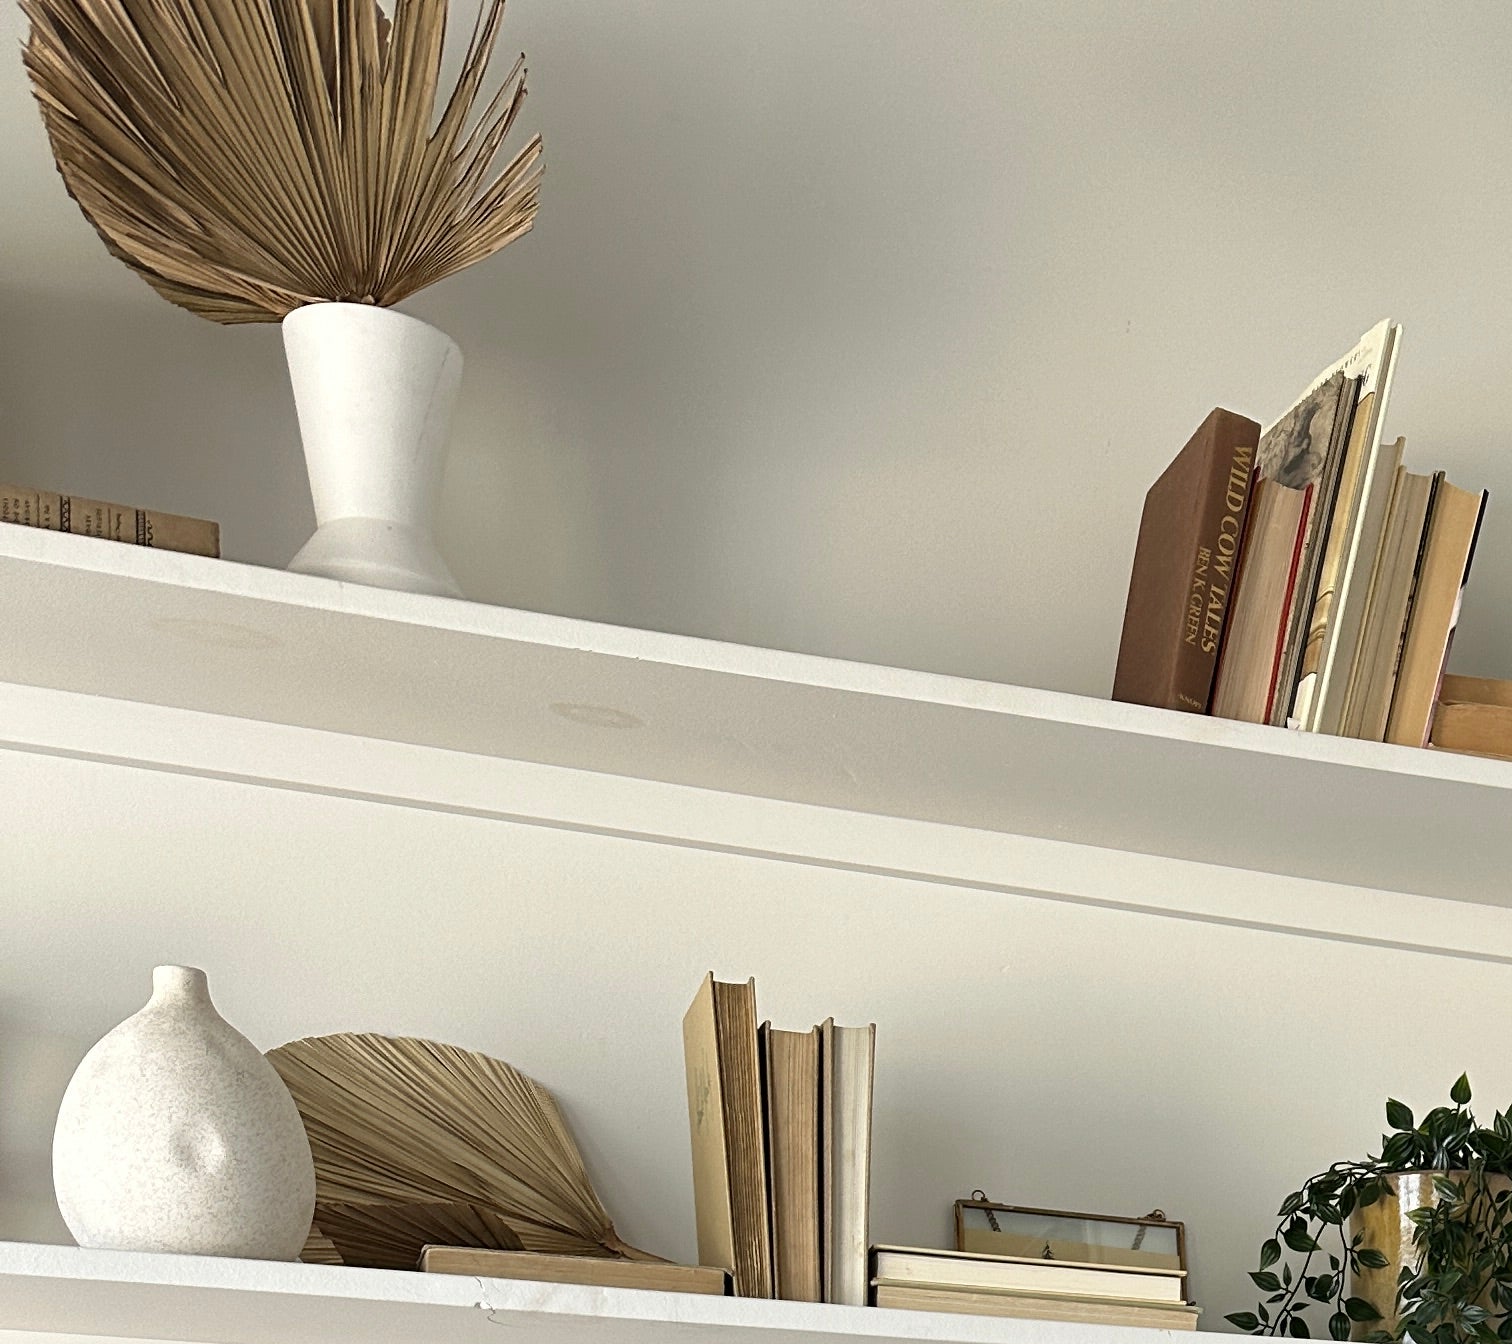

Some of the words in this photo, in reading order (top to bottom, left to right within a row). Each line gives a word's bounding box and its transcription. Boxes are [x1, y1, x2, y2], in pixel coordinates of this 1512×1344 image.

[1226, 446, 1253, 512] WILD
[1195, 546, 1212, 577] BEN
[1214, 515, 1240, 581] COW
[1186, 593, 1203, 646] GREEN
[1201, 583, 1228, 653] TALES
